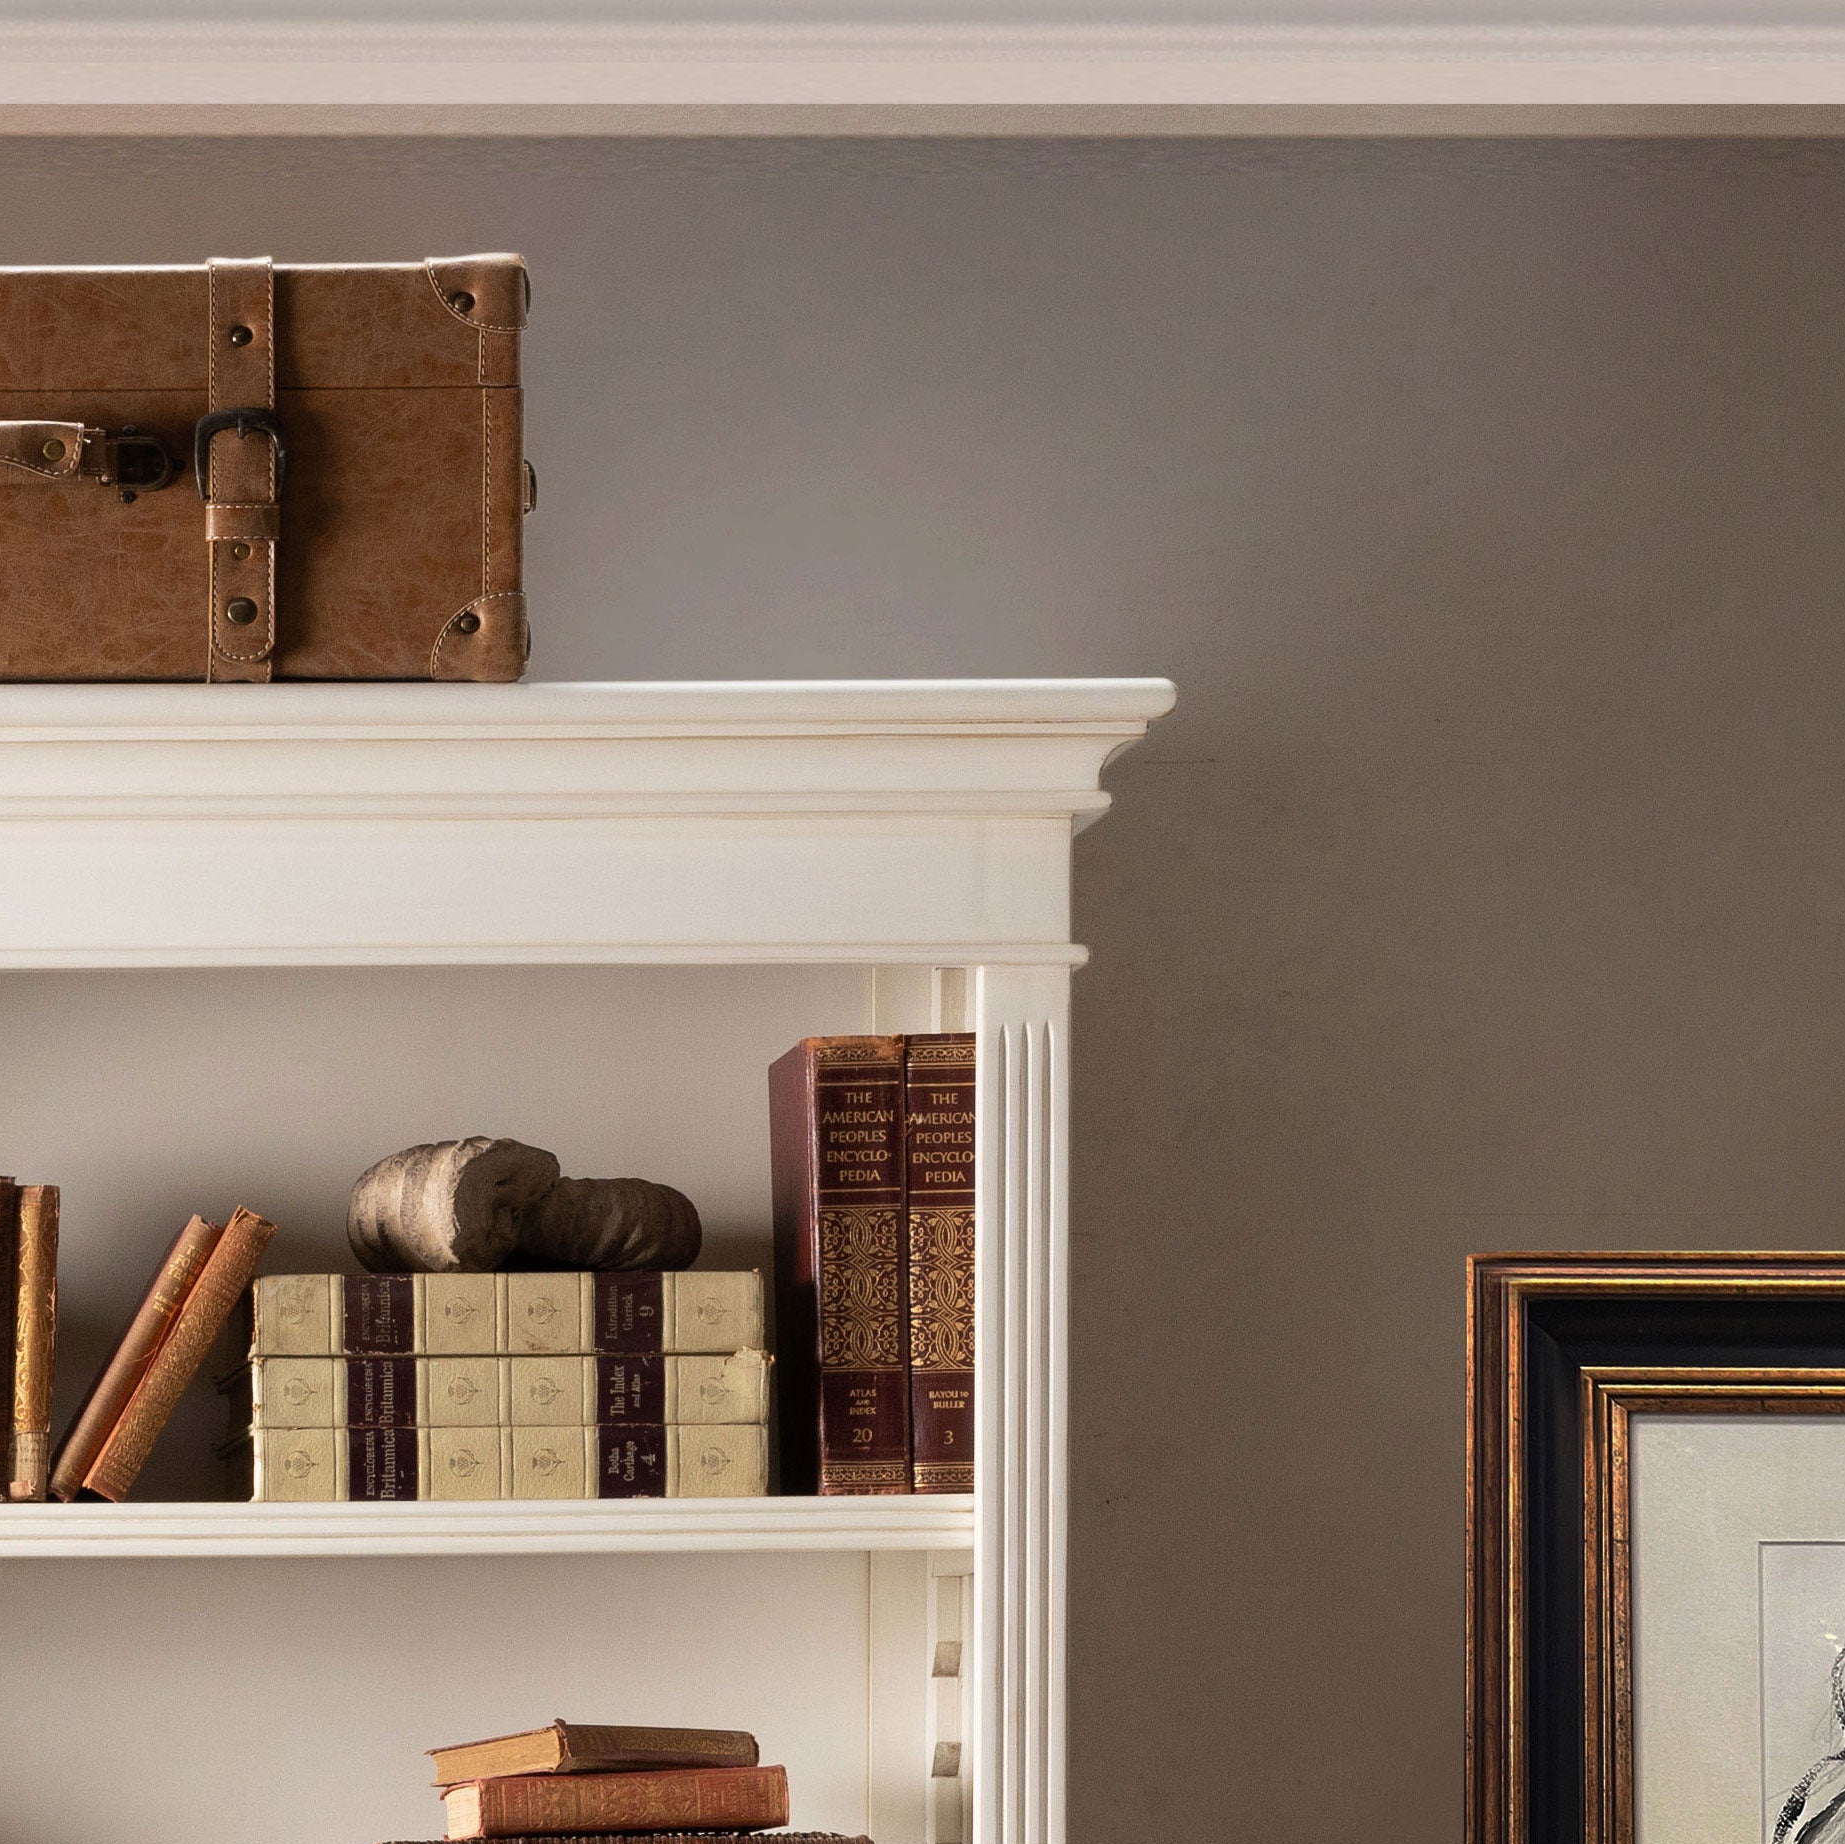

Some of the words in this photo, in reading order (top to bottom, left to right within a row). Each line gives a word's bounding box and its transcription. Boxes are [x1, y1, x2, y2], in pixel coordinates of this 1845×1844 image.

[844, 1092, 872, 1104] THE
[930, 1093, 958, 1104] THE
[822, 1110, 894, 1123] AMERICAN
[830, 1130, 887, 1143] PEOPLES
[916, 1132, 972, 1144] PEOPLES
[839, 1170, 881, 1181] PEDIA
[925, 1171, 966, 1183] PEDIA
[639, 1305, 655, 1317] 9
[611, 1365, 625, 1394] Index
[380, 1361, 395, 1425] Britannica
[849, 1389, 877, 1397] ATLAS
[611, 1394, 625, 1417] The
[849, 1407, 877, 1415] INDEX
[932, 1401, 965, 1409] BULLER
[852, 1428, 873, 1443] 20
[944, 1431, 954, 1445] 3
[380, 1428, 396, 1500] Britannica
[623, 1440, 637, 1482] Carthage
[641, 1453, 656, 1467] 4
